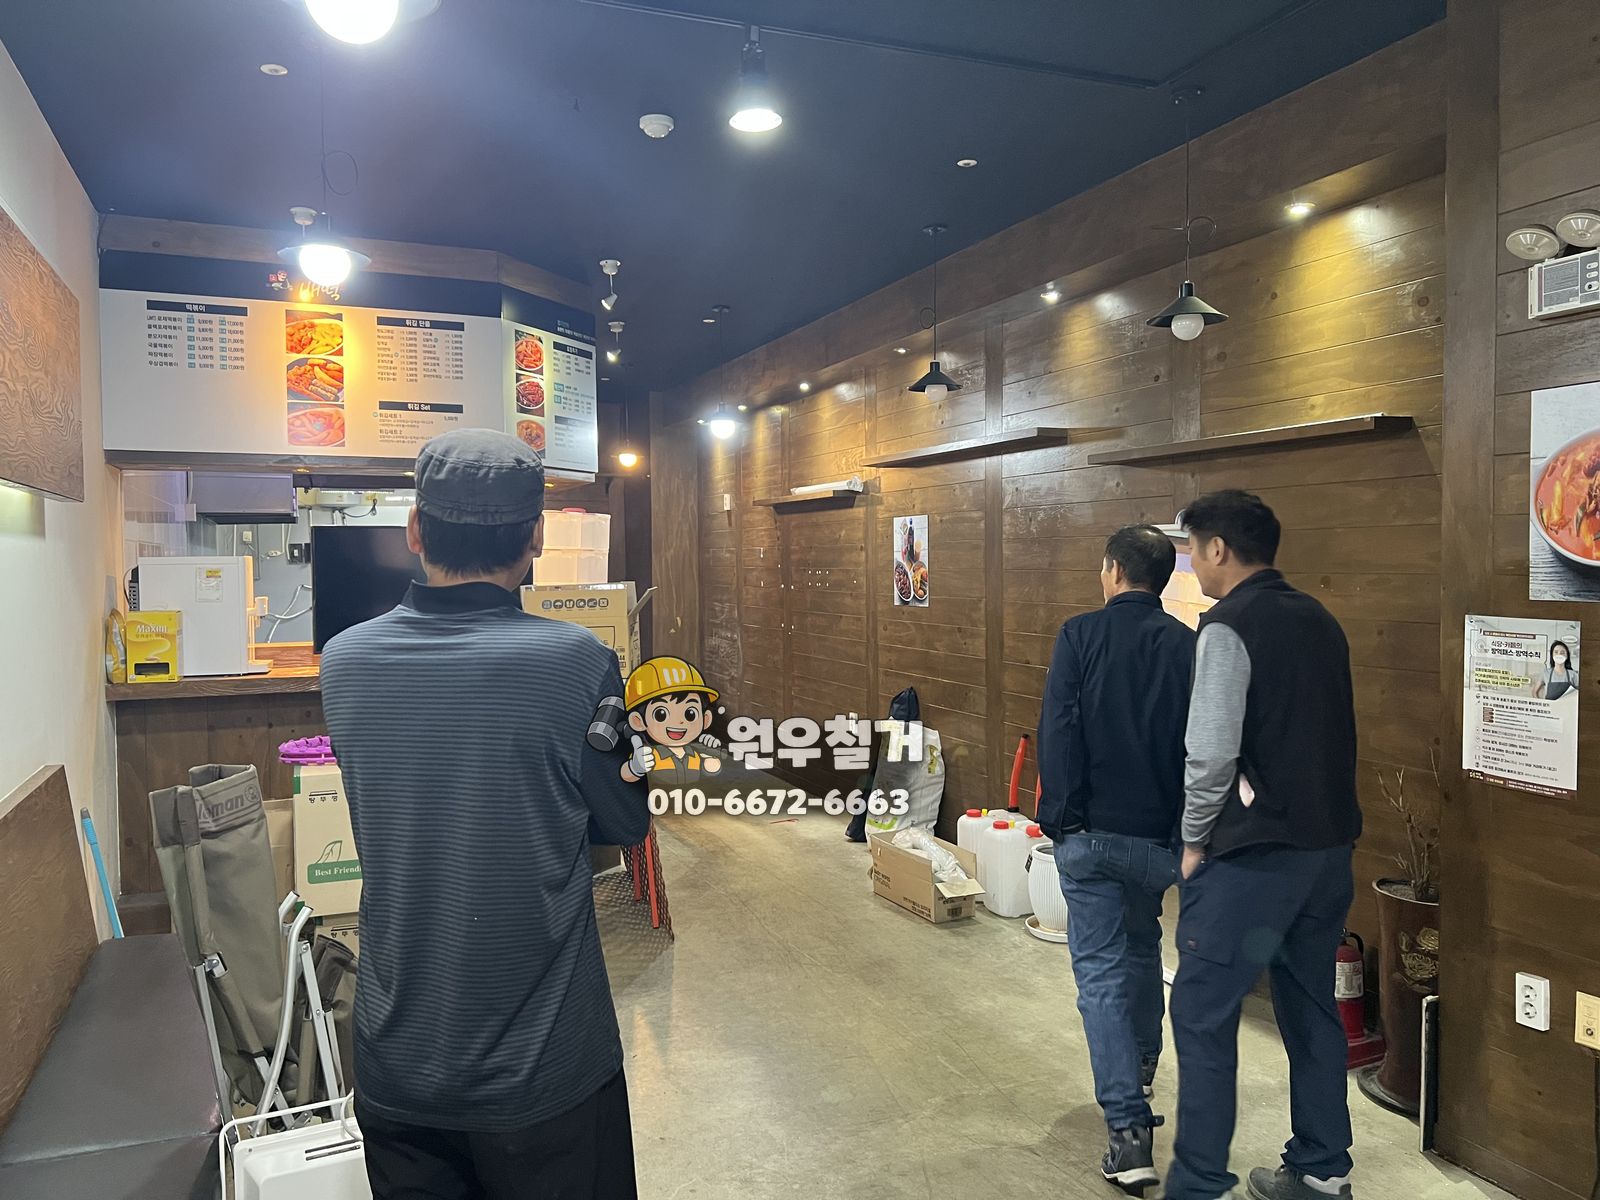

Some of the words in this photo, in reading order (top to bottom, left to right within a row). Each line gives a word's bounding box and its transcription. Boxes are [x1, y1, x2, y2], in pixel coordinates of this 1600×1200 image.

[185, 303, 206, 312] 떡볶이
[405, 319, 418, 327] 튀김
[419, 320, 431, 328] 단품
[407, 403, 420, 411] 튀김
[420, 403, 431, 411] Set
[1491, 647, 1514, 657] 방역패스
[1515, 649, 1541, 659] 방역수칙
[315, 869, 331, 877] Best
